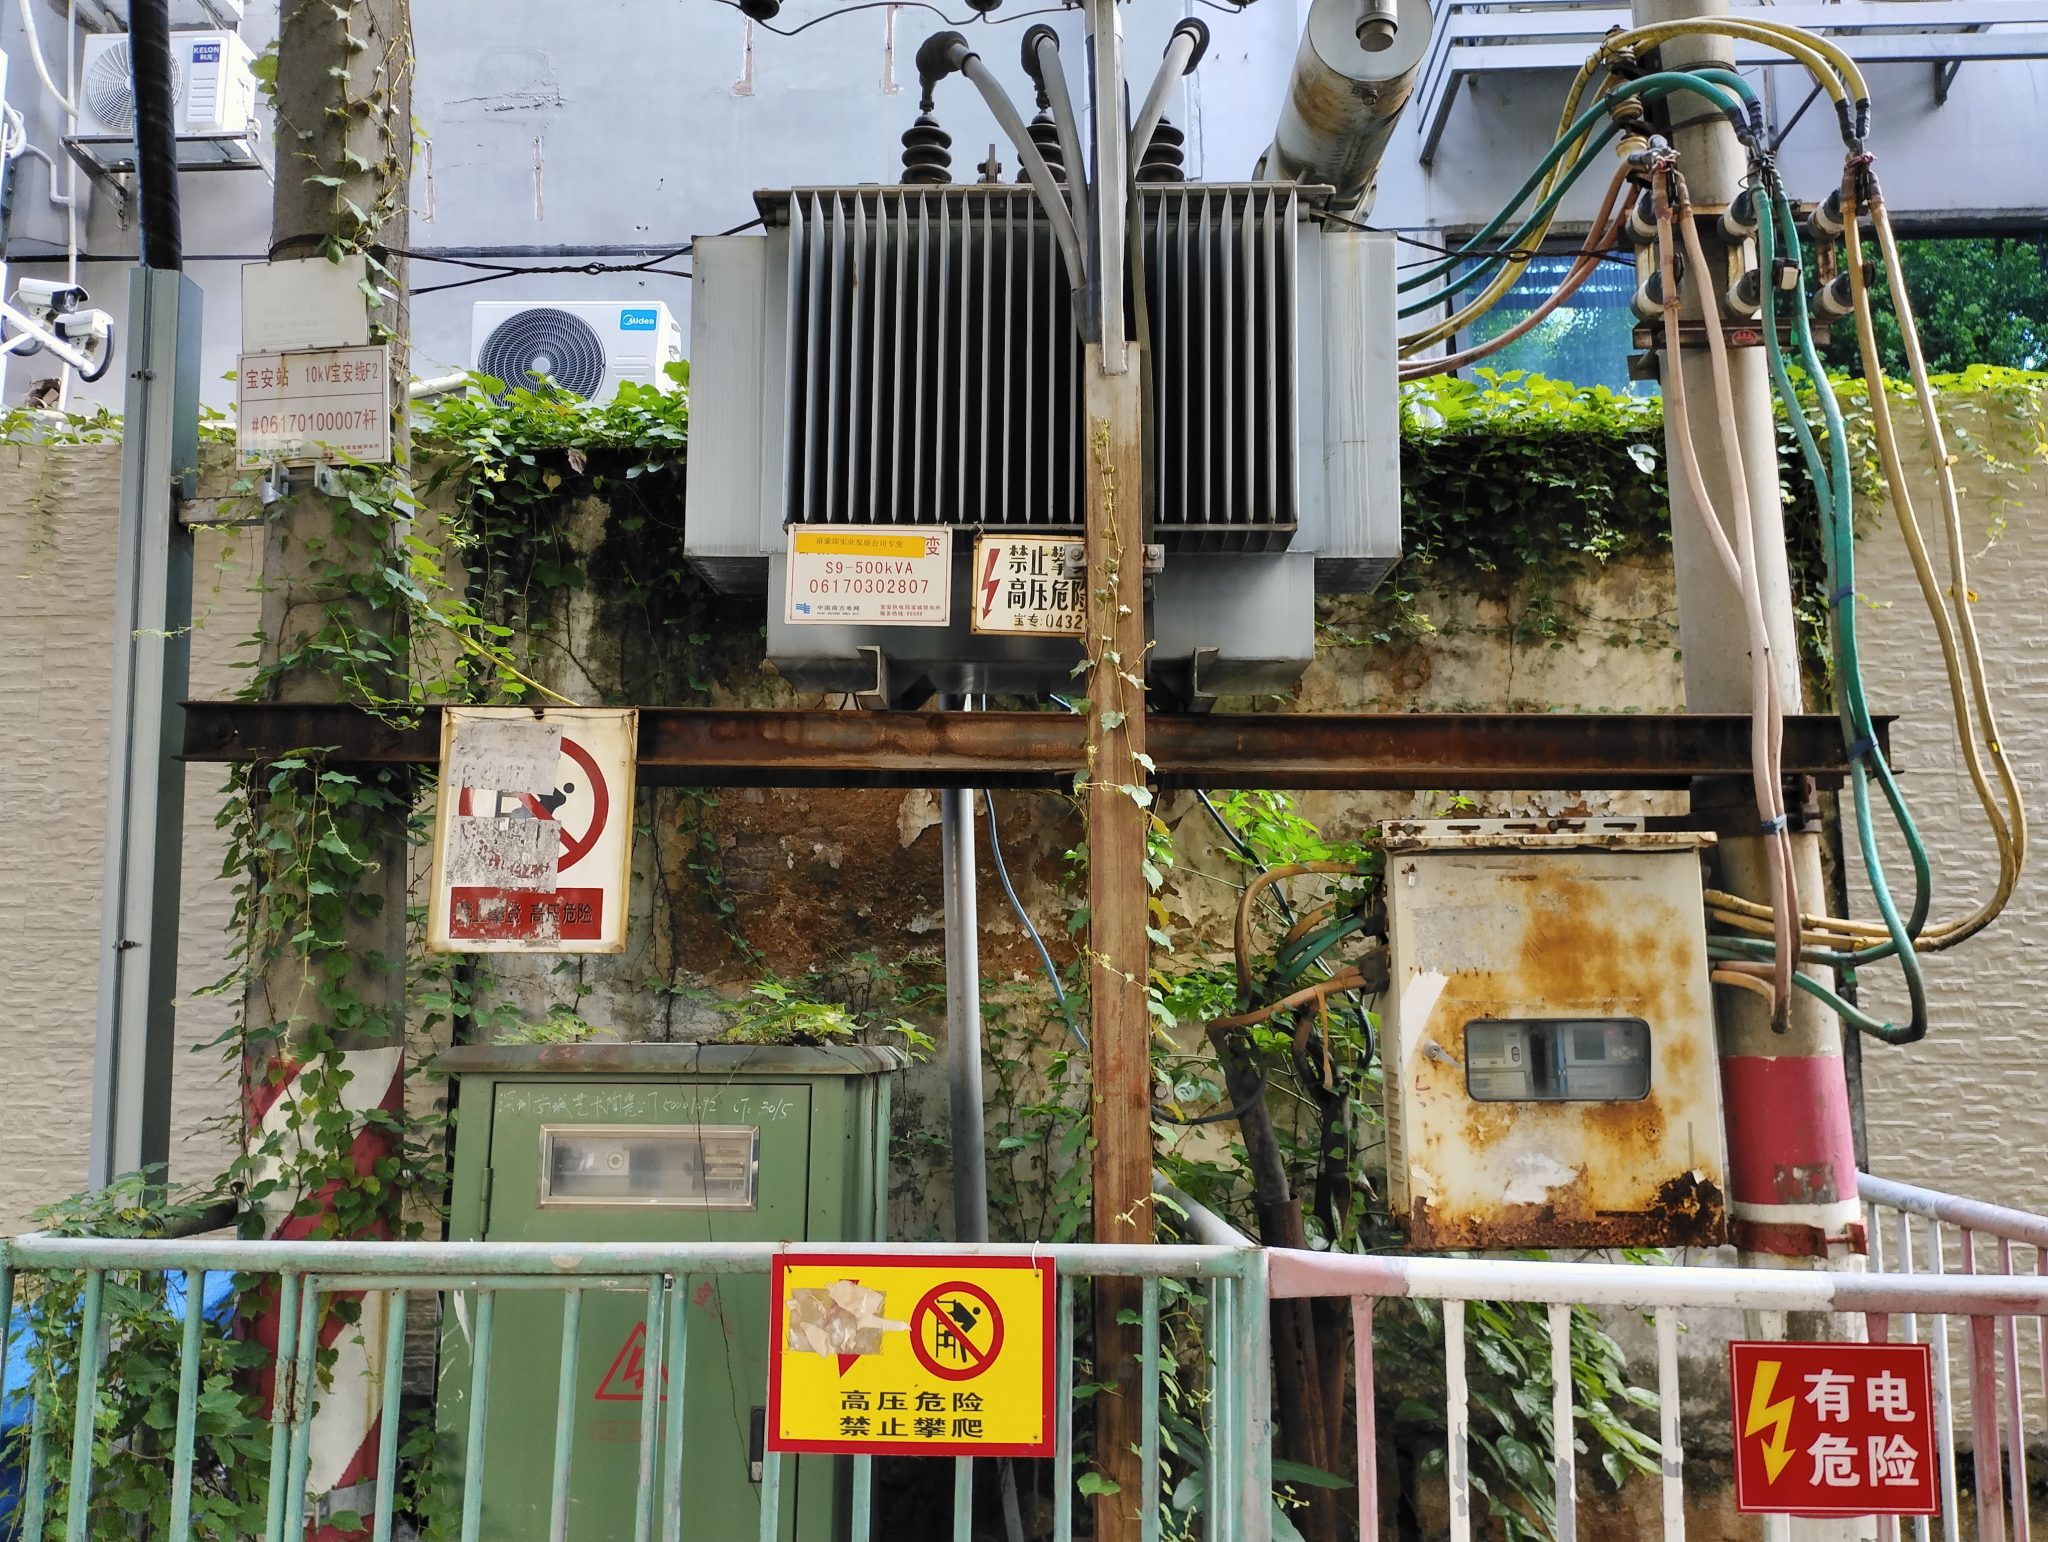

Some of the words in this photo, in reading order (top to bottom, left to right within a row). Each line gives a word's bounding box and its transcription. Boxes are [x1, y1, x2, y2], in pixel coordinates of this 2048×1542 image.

[193, 46, 219, 54] KELON
[625, 314, 655, 325] Midea
[246, 367, 289, 389] 宝安站
[251, 408, 377, 434] #06170100007杆
[825, 561, 913, 575] S9-500kVA
[1009, 545, 1065, 576] 禁止攀
[809, 579, 929, 594] 06170302807
[1007, 578, 1085, 612] 高压危险
[839, 1390, 984, 1413] 高压危险
[1803, 1368, 1916, 1423] 有电
[839, 1416, 984, 1439] 禁止攀爬
[1806, 1432, 1920, 1488] 危险
